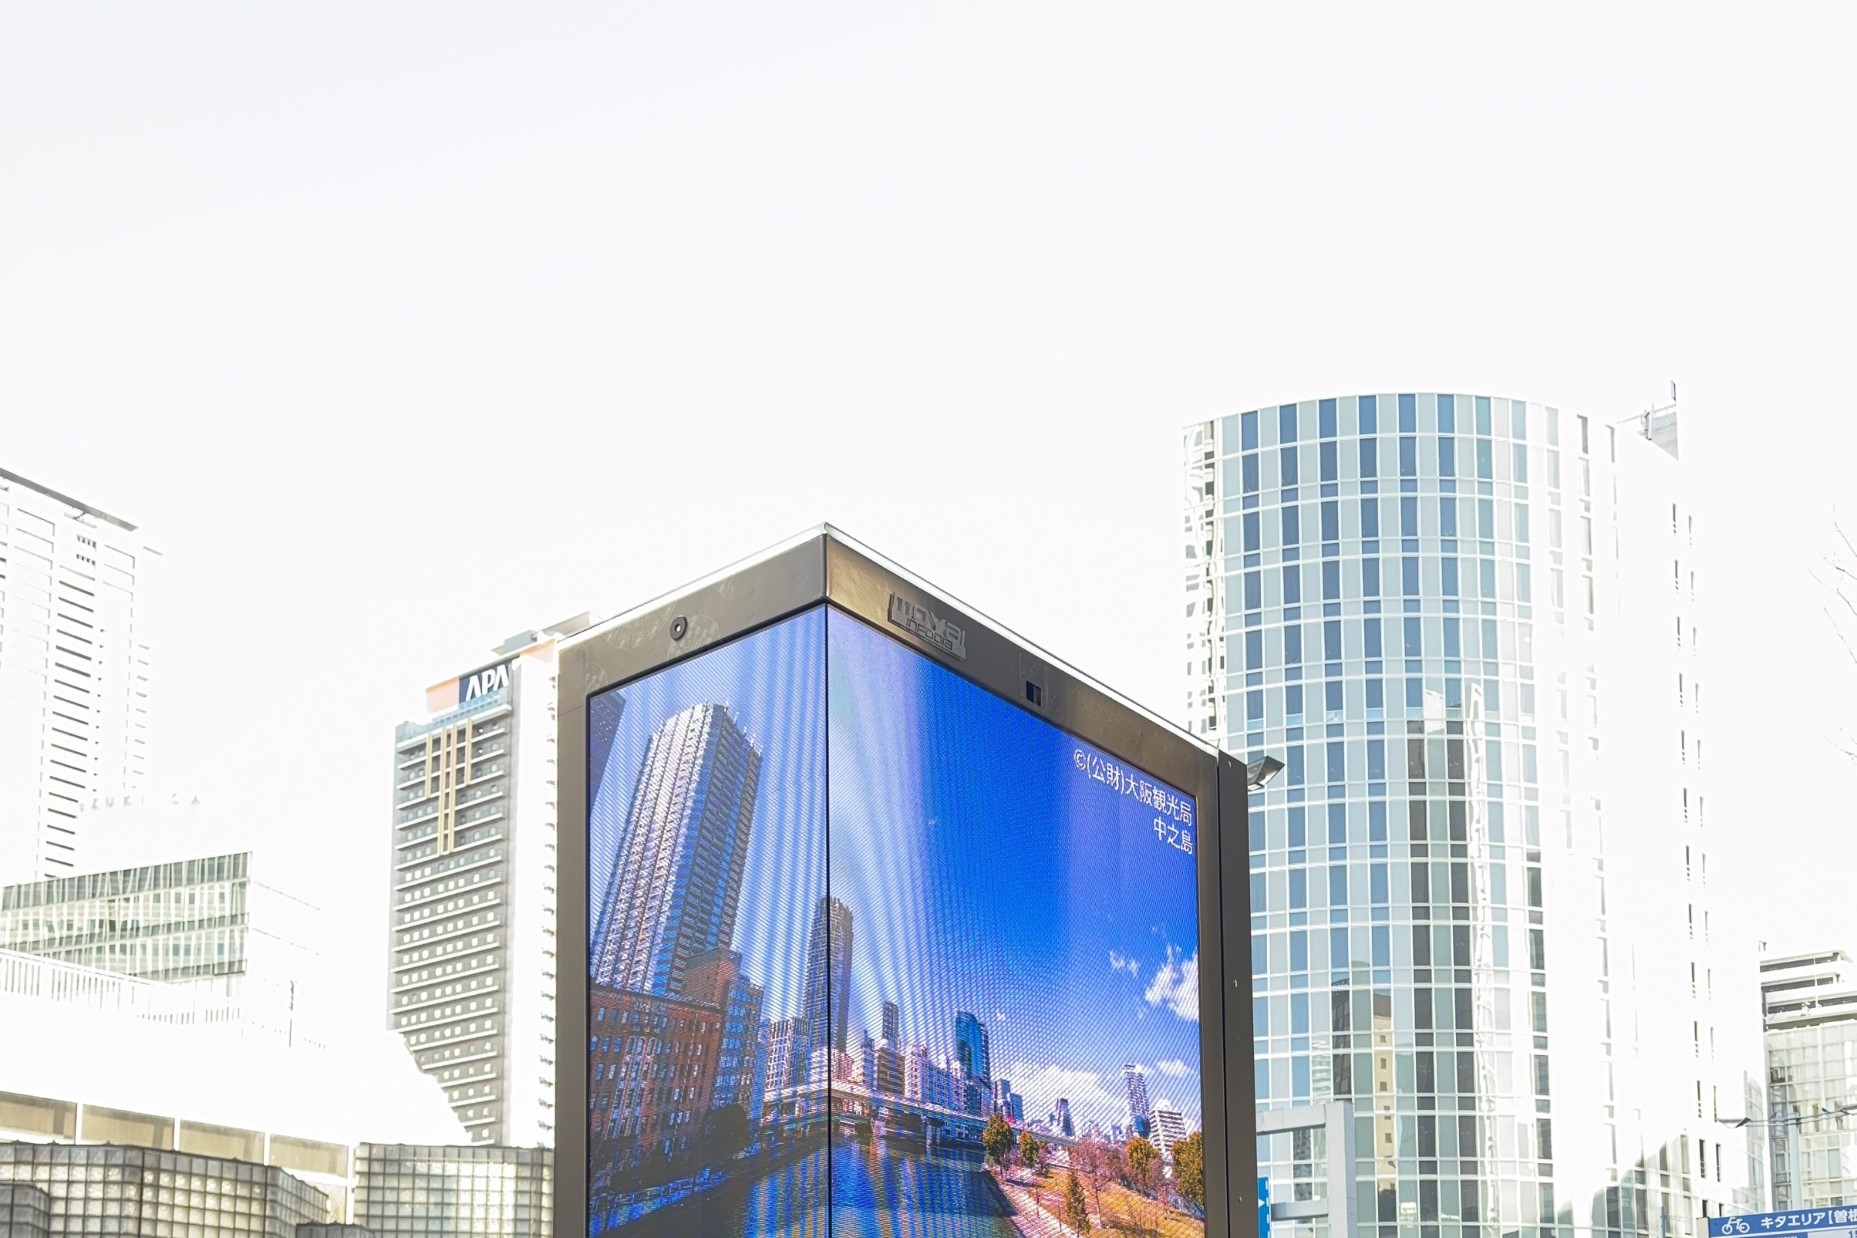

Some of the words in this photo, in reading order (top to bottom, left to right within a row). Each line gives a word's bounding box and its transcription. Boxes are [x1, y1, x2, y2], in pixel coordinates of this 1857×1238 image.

[465, 664, 510, 702] APA
[1153, 816, 1193, 855] 中之島
